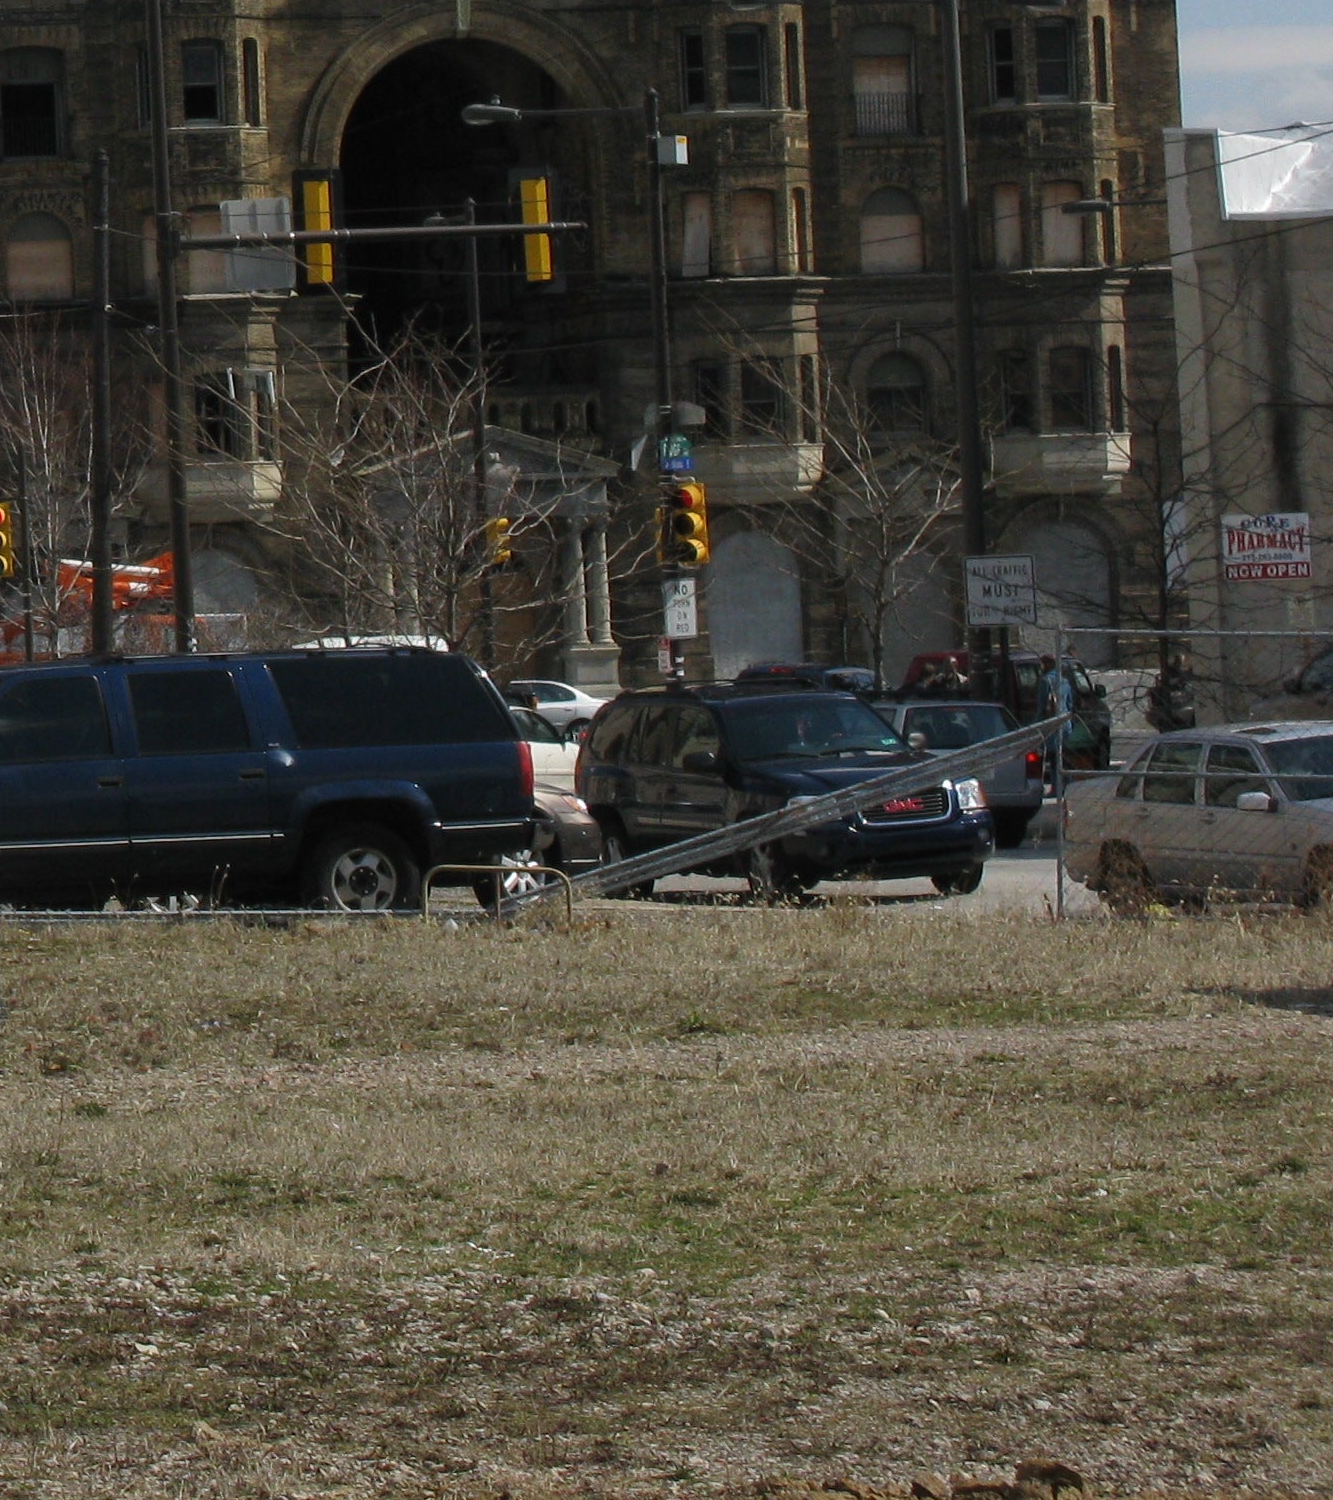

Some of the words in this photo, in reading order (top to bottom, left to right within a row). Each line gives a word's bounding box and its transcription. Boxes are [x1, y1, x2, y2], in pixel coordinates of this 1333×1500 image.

[1227, 526, 1305, 556] PHARMACY
[1228, 564, 1263, 579] NOW
[1267, 563, 1309, 577] OPEN
[674, 584, 688, 595] NO
[982, 583, 1019, 597] MUST
[883, 797, 925, 813] GMC
